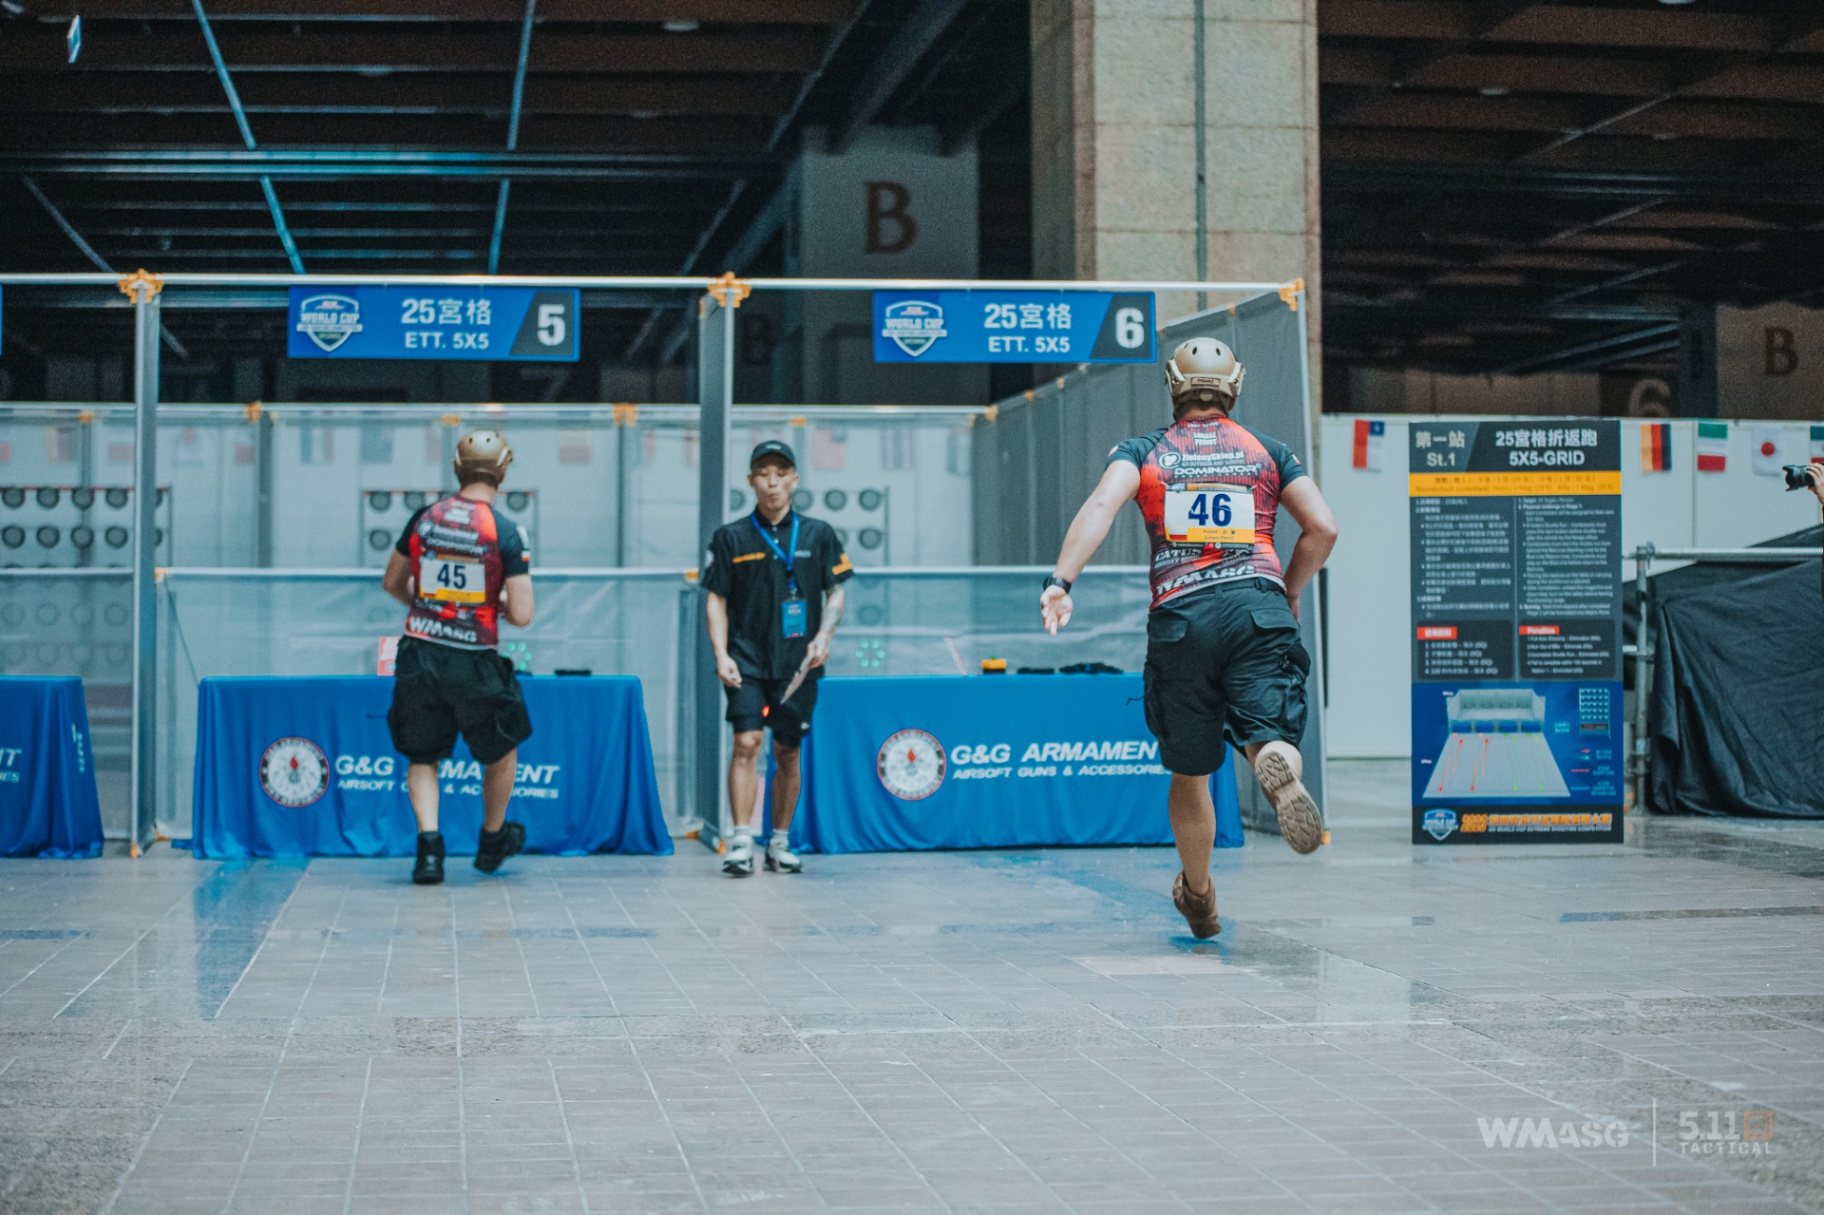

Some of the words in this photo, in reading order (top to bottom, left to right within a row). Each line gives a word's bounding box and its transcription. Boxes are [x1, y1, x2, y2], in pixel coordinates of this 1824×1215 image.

[866, 181, 917, 254] B
[301, 312, 337, 324] WORLD
[339, 313, 360, 325] CUP
[401, 298, 491, 325] 25宮格
[984, 303, 1071, 330] 25宮格
[537, 304, 566, 346] 5
[885, 318, 922, 330] WORLD
[924, 318, 944, 330] CUP
[1115, 307, 1144, 349] 6
[404, 332, 446, 349] ETT.
[453, 333, 489, 349] 5X5
[988, 336, 1029, 352] ETT.
[1035, 337, 1070, 352] 5X5
[1765, 326, 1799, 376] B
[1415, 430, 1465, 448] 第一站
[1495, 429, 1597, 448] 25宮格折返跑
[1427, 452, 1456, 467] St.1
[1509, 450, 1585, 466] 5X5-GRID
[1188, 493, 1232, 527] 46
[437, 563, 466, 590] 45
[951, 743, 1011, 766] G&G
[335, 755, 394, 776] G&G
[953, 766, 1012, 780] AIRSOFT
[1017, 766, 1057, 778] GUNS
[1063, 766, 1073, 776] &
[337, 779, 394, 792] AIRSOFT
[444, 783, 454, 794] &
